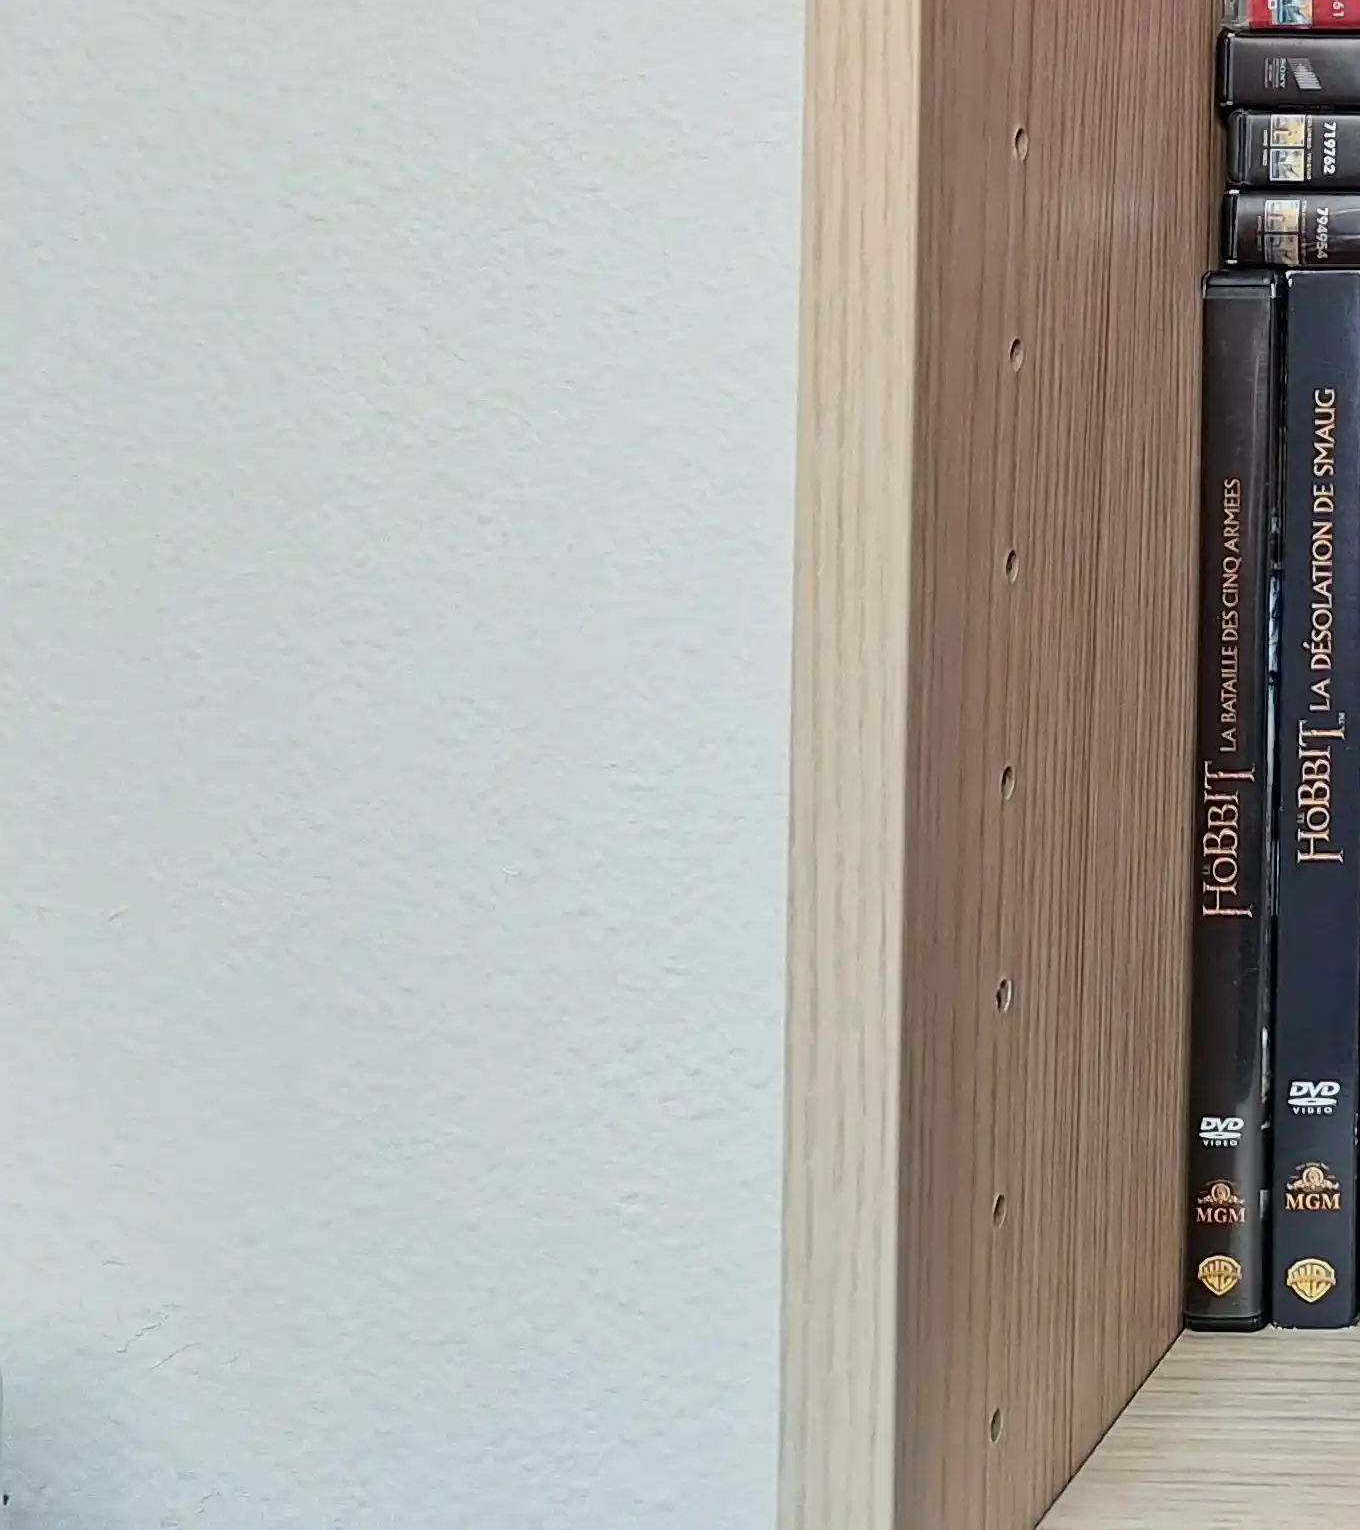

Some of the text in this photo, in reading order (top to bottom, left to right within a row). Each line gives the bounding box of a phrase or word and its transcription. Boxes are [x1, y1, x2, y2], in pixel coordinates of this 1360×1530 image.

[1323, 121, 1337, 175] 719762
[1316, 207, 1330, 260] 794954
[1222, 556, 1242, 608] CINQ
[1221, 610, 1239, 642] DES
[1296, 388, 1344, 864] HOBBIT LA DÉSOLATION DE SMAUG
[1219, 645, 1238, 723] BATAILLE
[1219, 727, 1237, 752] LA
[1202, 759, 1256, 918] HOBBIT
